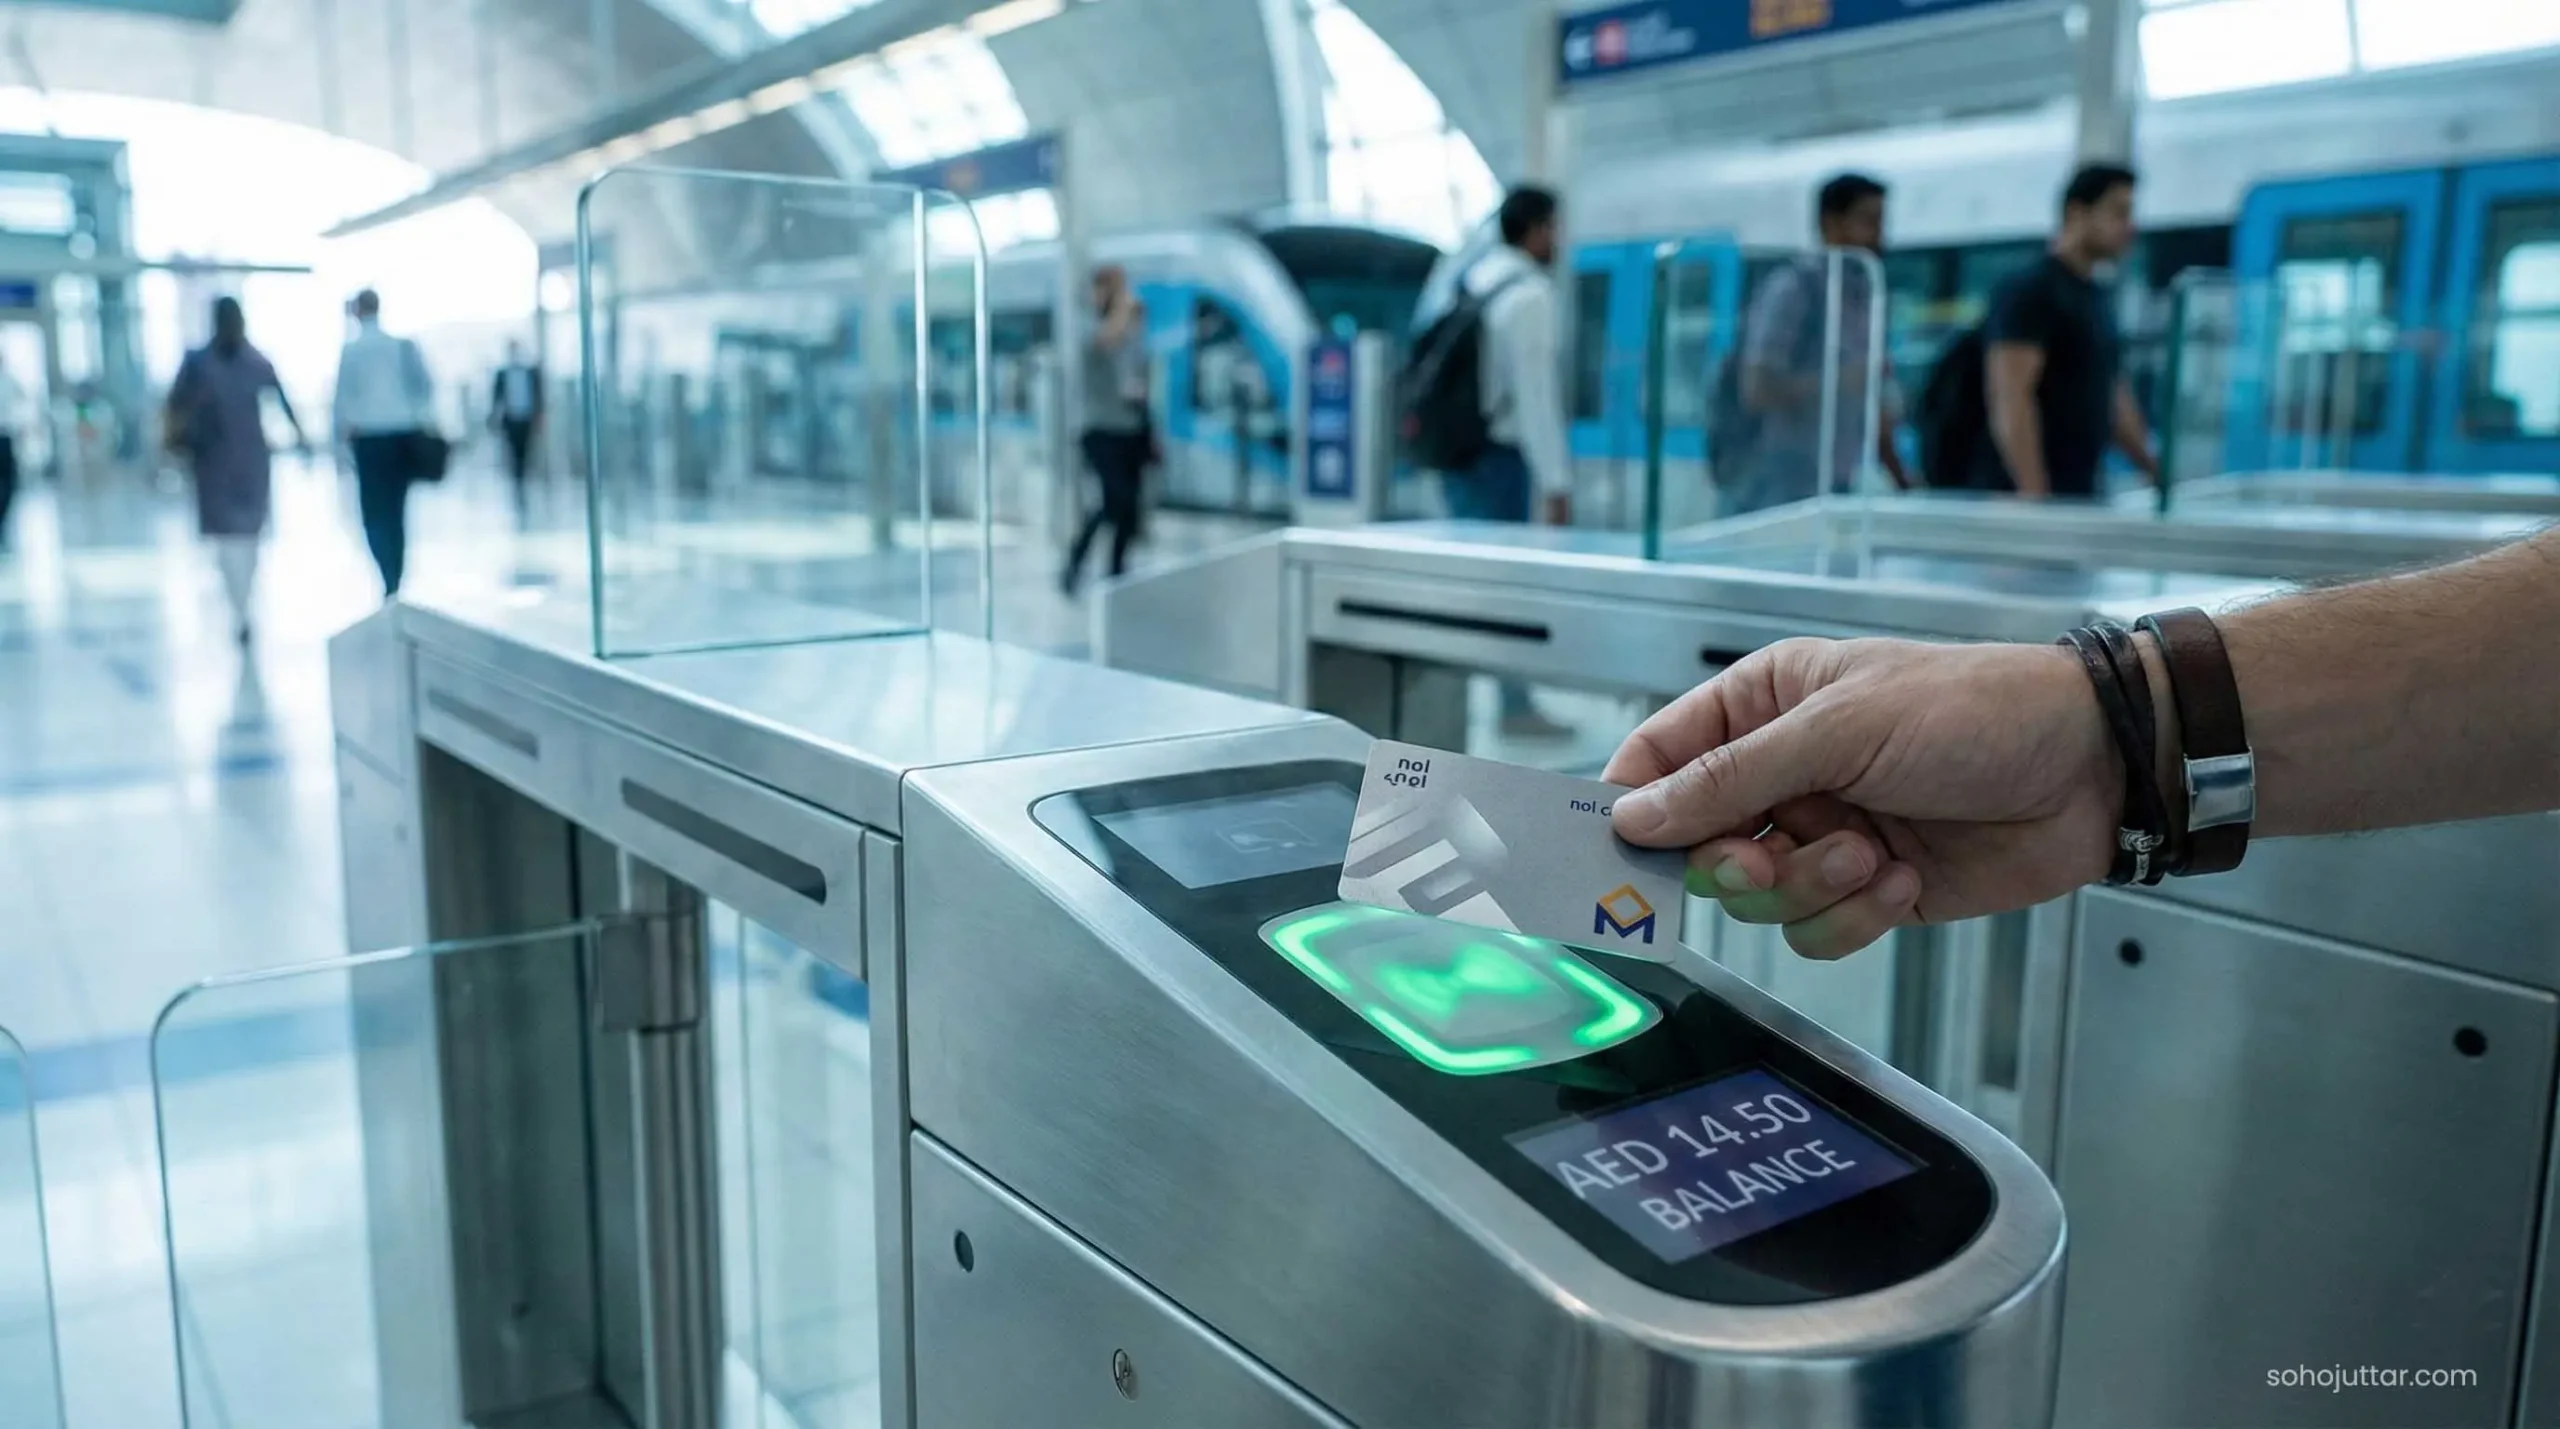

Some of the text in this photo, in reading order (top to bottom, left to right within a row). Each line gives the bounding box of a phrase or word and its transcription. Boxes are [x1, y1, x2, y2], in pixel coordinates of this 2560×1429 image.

[1398, 758, 1430, 773] nol
[1570, 800, 1596, 814] nol
[1556, 1092, 1812, 1198] AED 14.50
[1639, 1139, 1857, 1231] BALANCE
